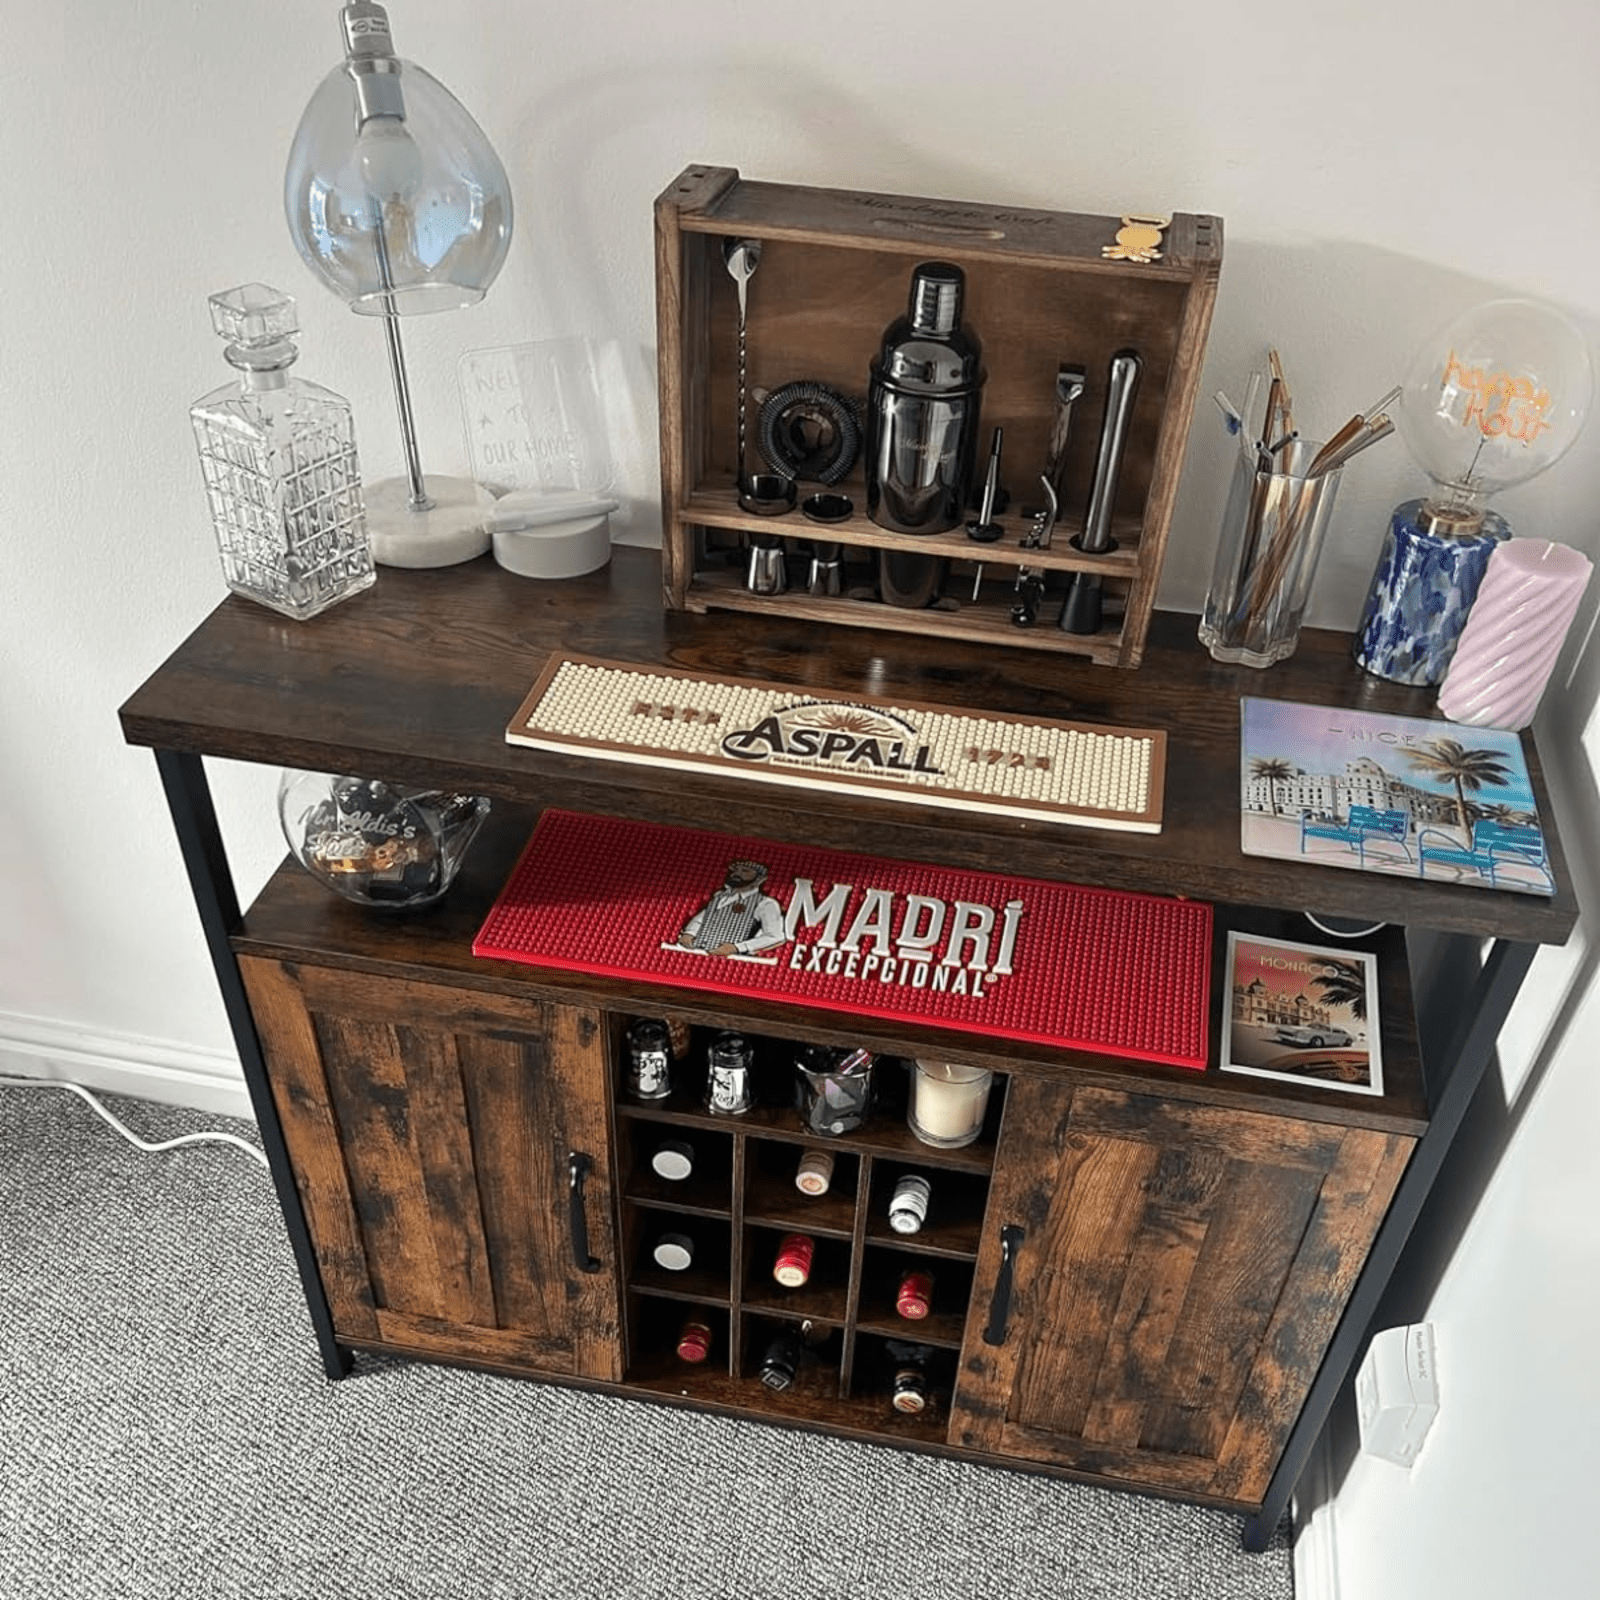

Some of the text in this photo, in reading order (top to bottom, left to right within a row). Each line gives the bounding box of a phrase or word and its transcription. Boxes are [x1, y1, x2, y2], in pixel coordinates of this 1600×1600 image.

[721, 716, 945, 776] ASPALL
[785, 878, 1024, 975] MADRÍ
[789, 944, 986, 998] EXCEPCIONAL
[1260, 955, 1339, 979] MONACO
